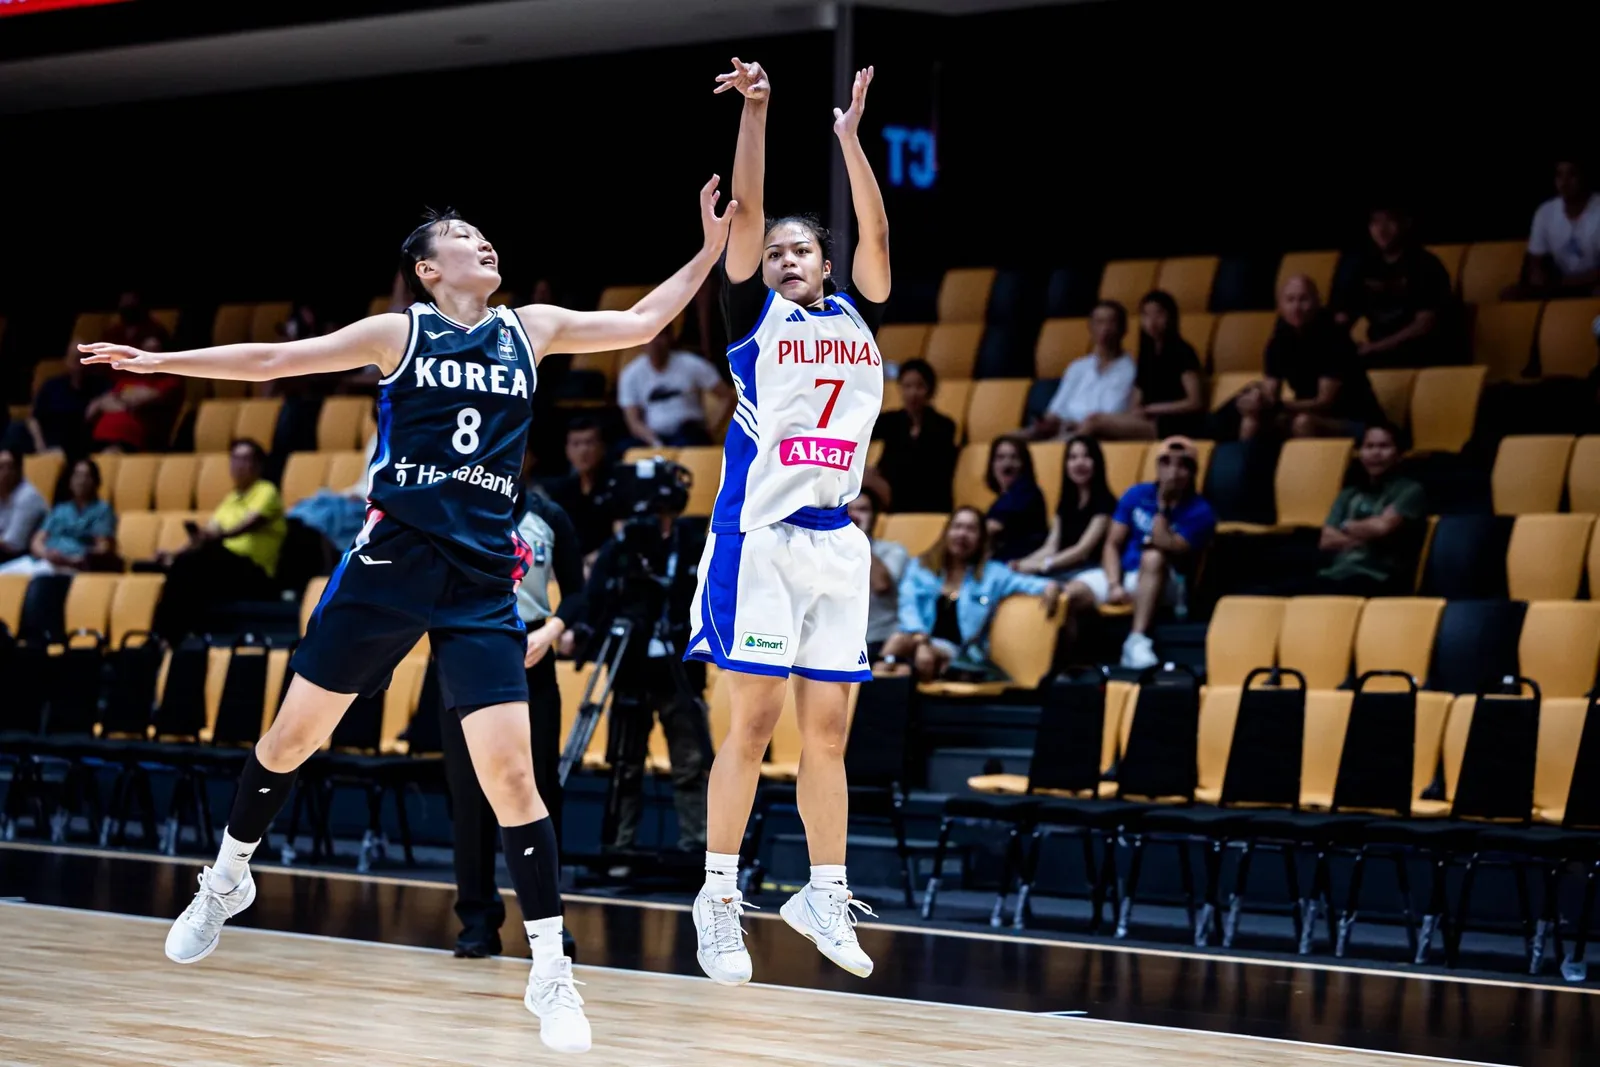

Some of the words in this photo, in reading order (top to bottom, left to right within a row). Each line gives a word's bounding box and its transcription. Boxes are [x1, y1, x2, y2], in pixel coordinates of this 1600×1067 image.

[414, 356, 529, 400] KOREA
[814, 378, 846, 429] 7
[451, 407, 482, 455] 8
[756, 638, 784, 650] Smart
